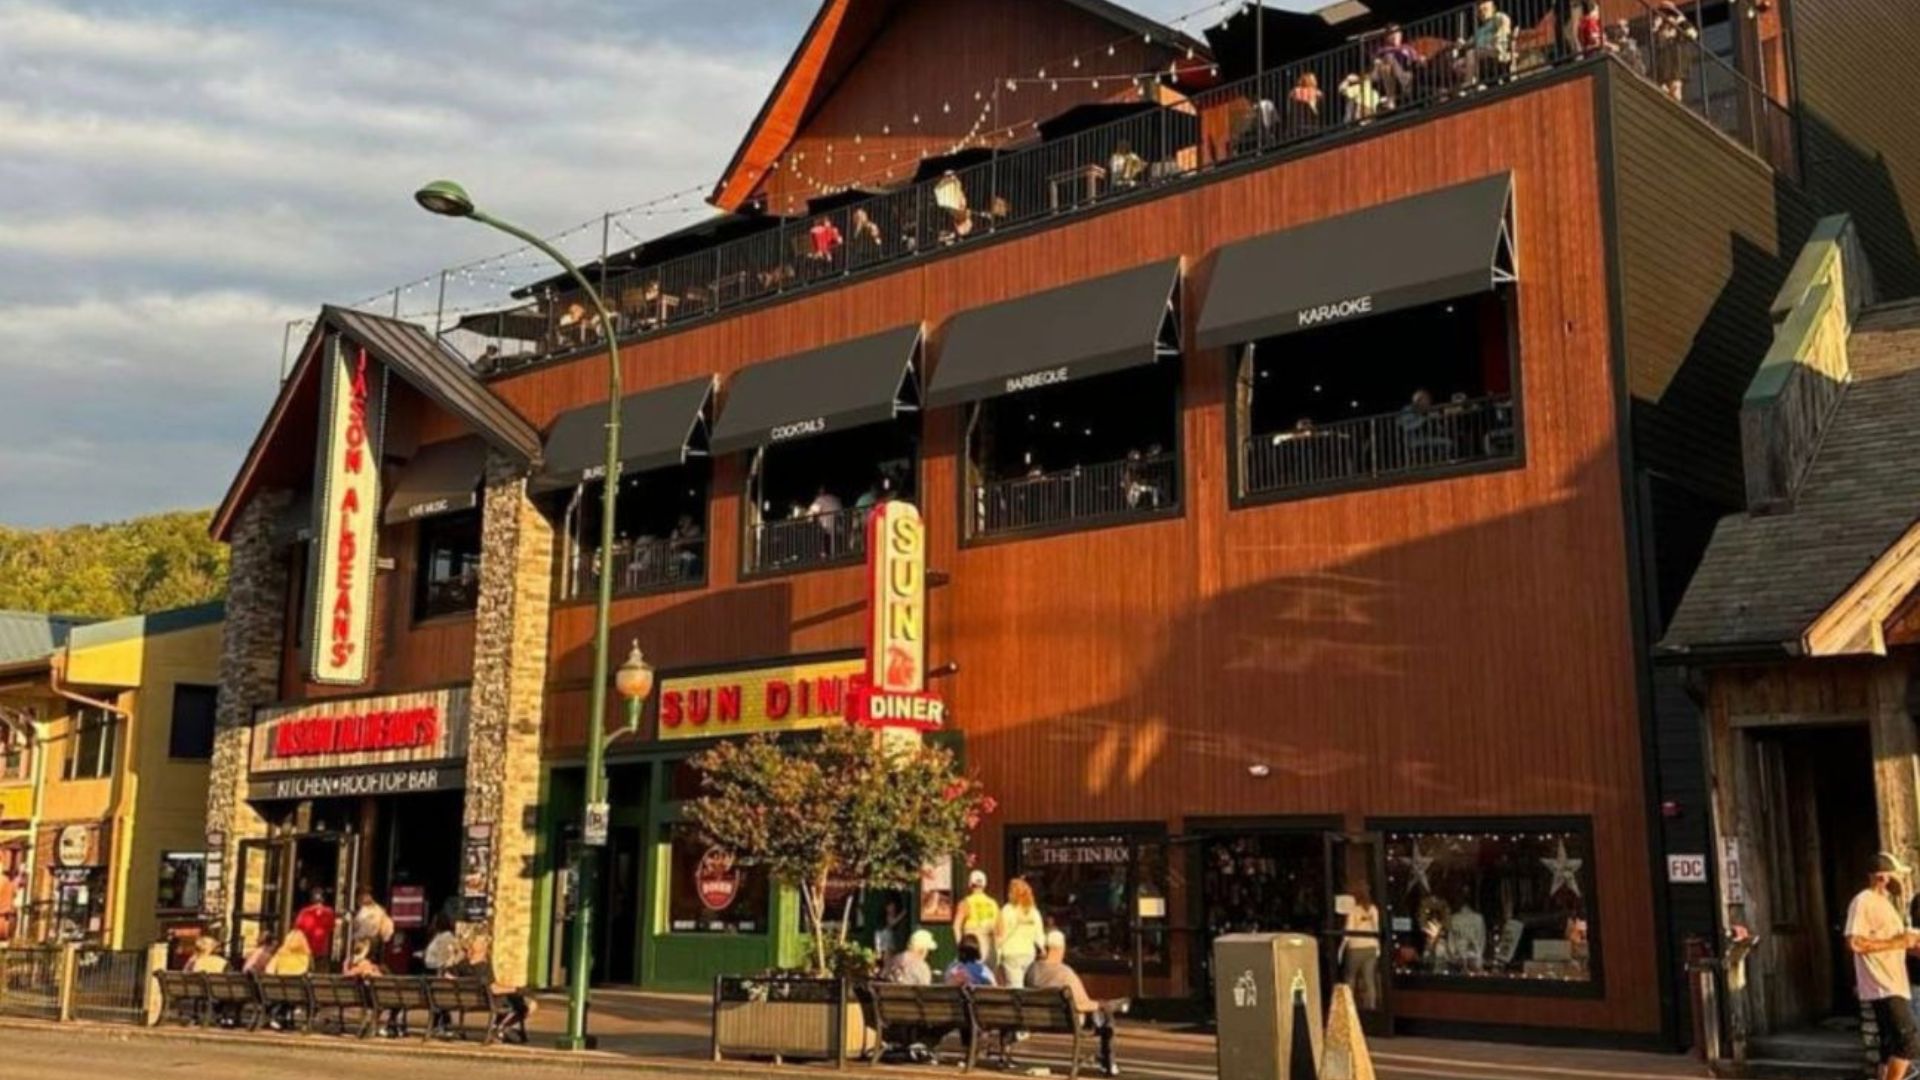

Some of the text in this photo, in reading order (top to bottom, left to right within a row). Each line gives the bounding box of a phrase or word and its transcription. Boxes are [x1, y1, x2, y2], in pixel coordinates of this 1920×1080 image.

[1298, 295, 1372, 326] KARAOKE
[1006, 366, 1068, 393] BARBEQUE
[344, 346, 368, 475] JASON
[771, 416, 825, 440] COCKTAILS
[891, 516, 919, 642] SUN
[661, 684, 742, 729] SUN
[870, 694, 944, 726] DINER
[277, 769, 438, 799] KITCHEN ROOFTOP BAR
[1043, 848, 1072, 864] THE
[1075, 846, 1102, 864] TIN
[1671, 859, 1702, 877] FDC
